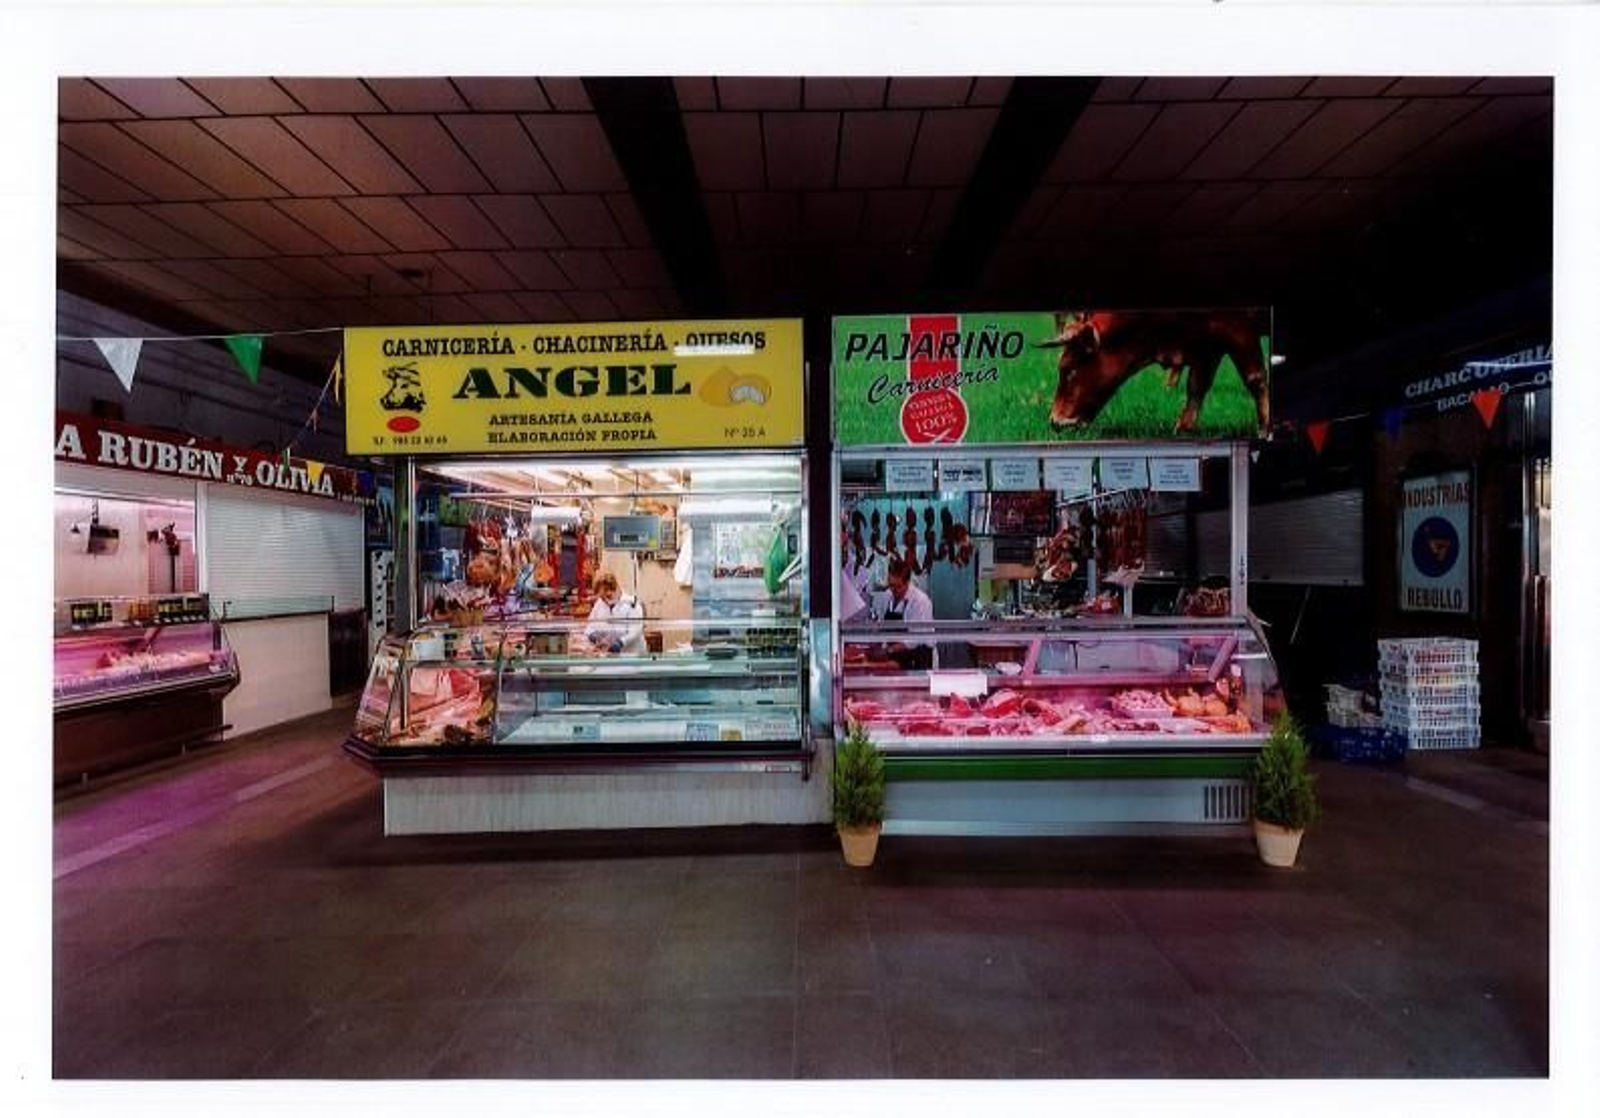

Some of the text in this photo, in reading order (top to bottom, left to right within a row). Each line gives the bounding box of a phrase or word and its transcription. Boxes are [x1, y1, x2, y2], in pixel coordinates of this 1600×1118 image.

[382, 330, 516, 357] CARNICERÍA
[533, 328, 667, 354] CHACINERÍA
[845, 324, 1024, 361] PAJARIÑO
[451, 363, 692, 400] ANGEL
[867, 364, 1000, 404] Carnicería
[1436, 381, 1510, 413] BACAO
[581, 410, 653, 424] GALLEGA
[488, 428, 657, 444] ELABORACIÓN PROPIA
[97, 429, 224, 480] RUBÉN
[1402, 482, 1472, 508] INDUSTRIAS
